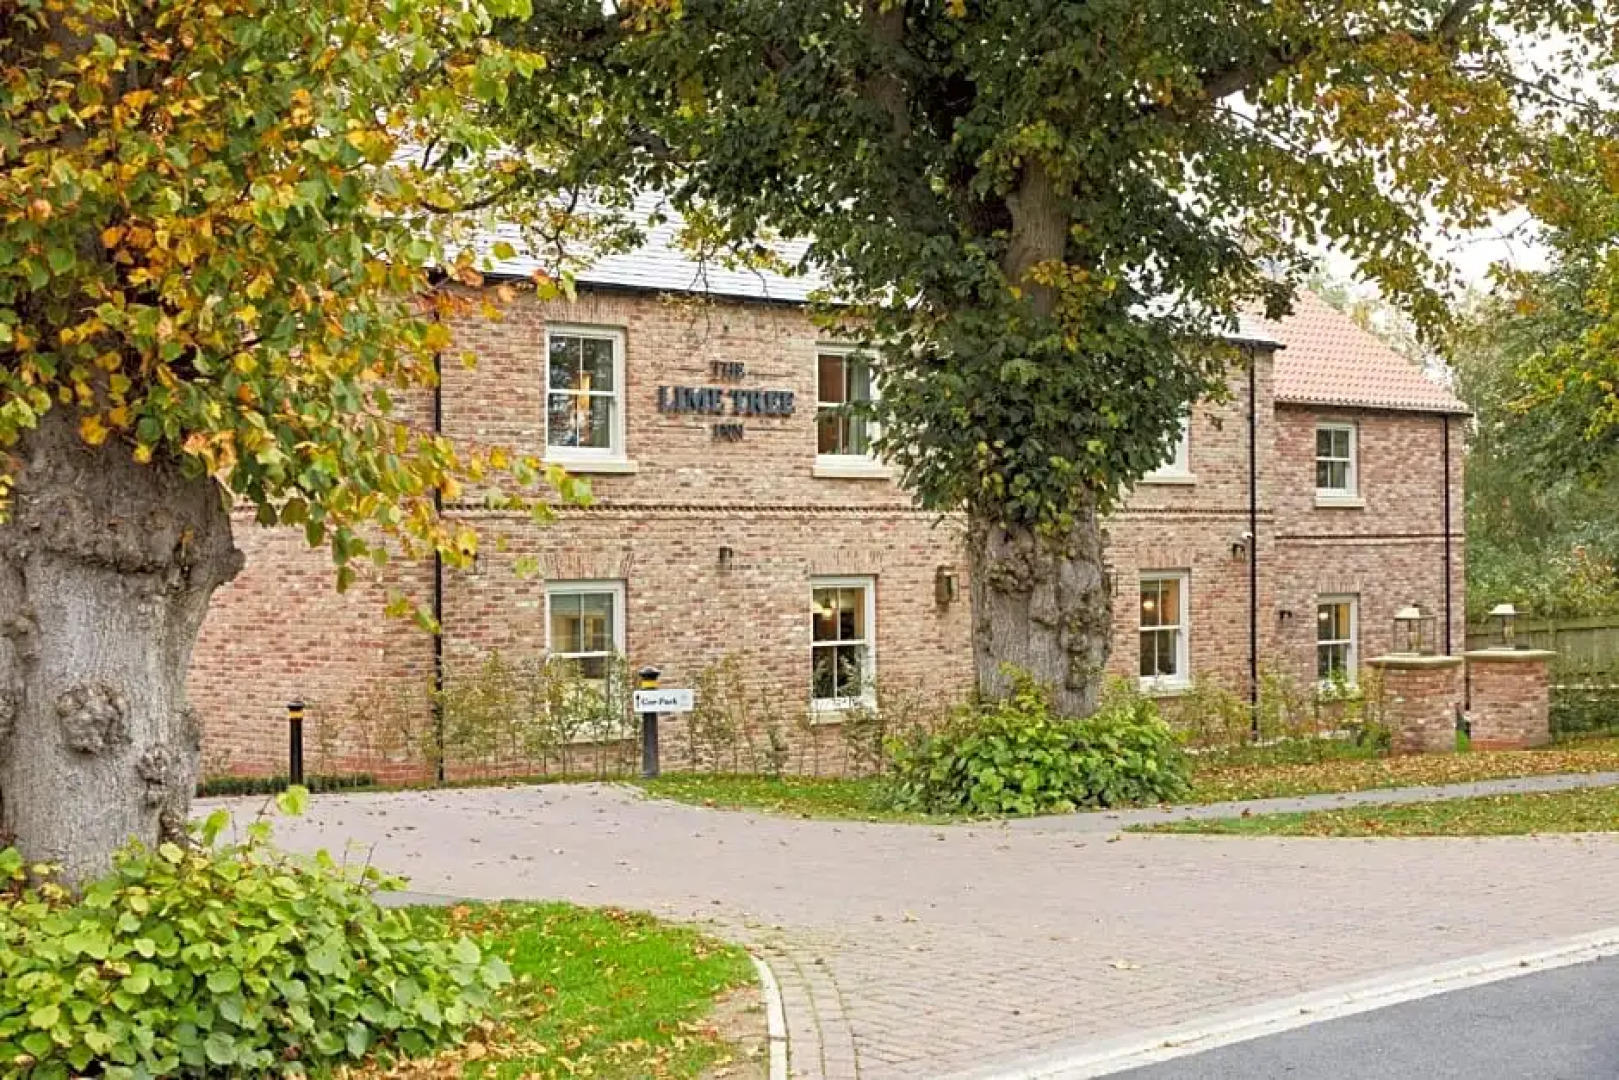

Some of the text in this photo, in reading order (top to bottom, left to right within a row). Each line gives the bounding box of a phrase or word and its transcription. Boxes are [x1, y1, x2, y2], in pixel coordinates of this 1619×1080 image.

[709, 360, 745, 379] THE
[658, 386, 795, 416] LIME TREE
[711, 423, 743, 441] INN
